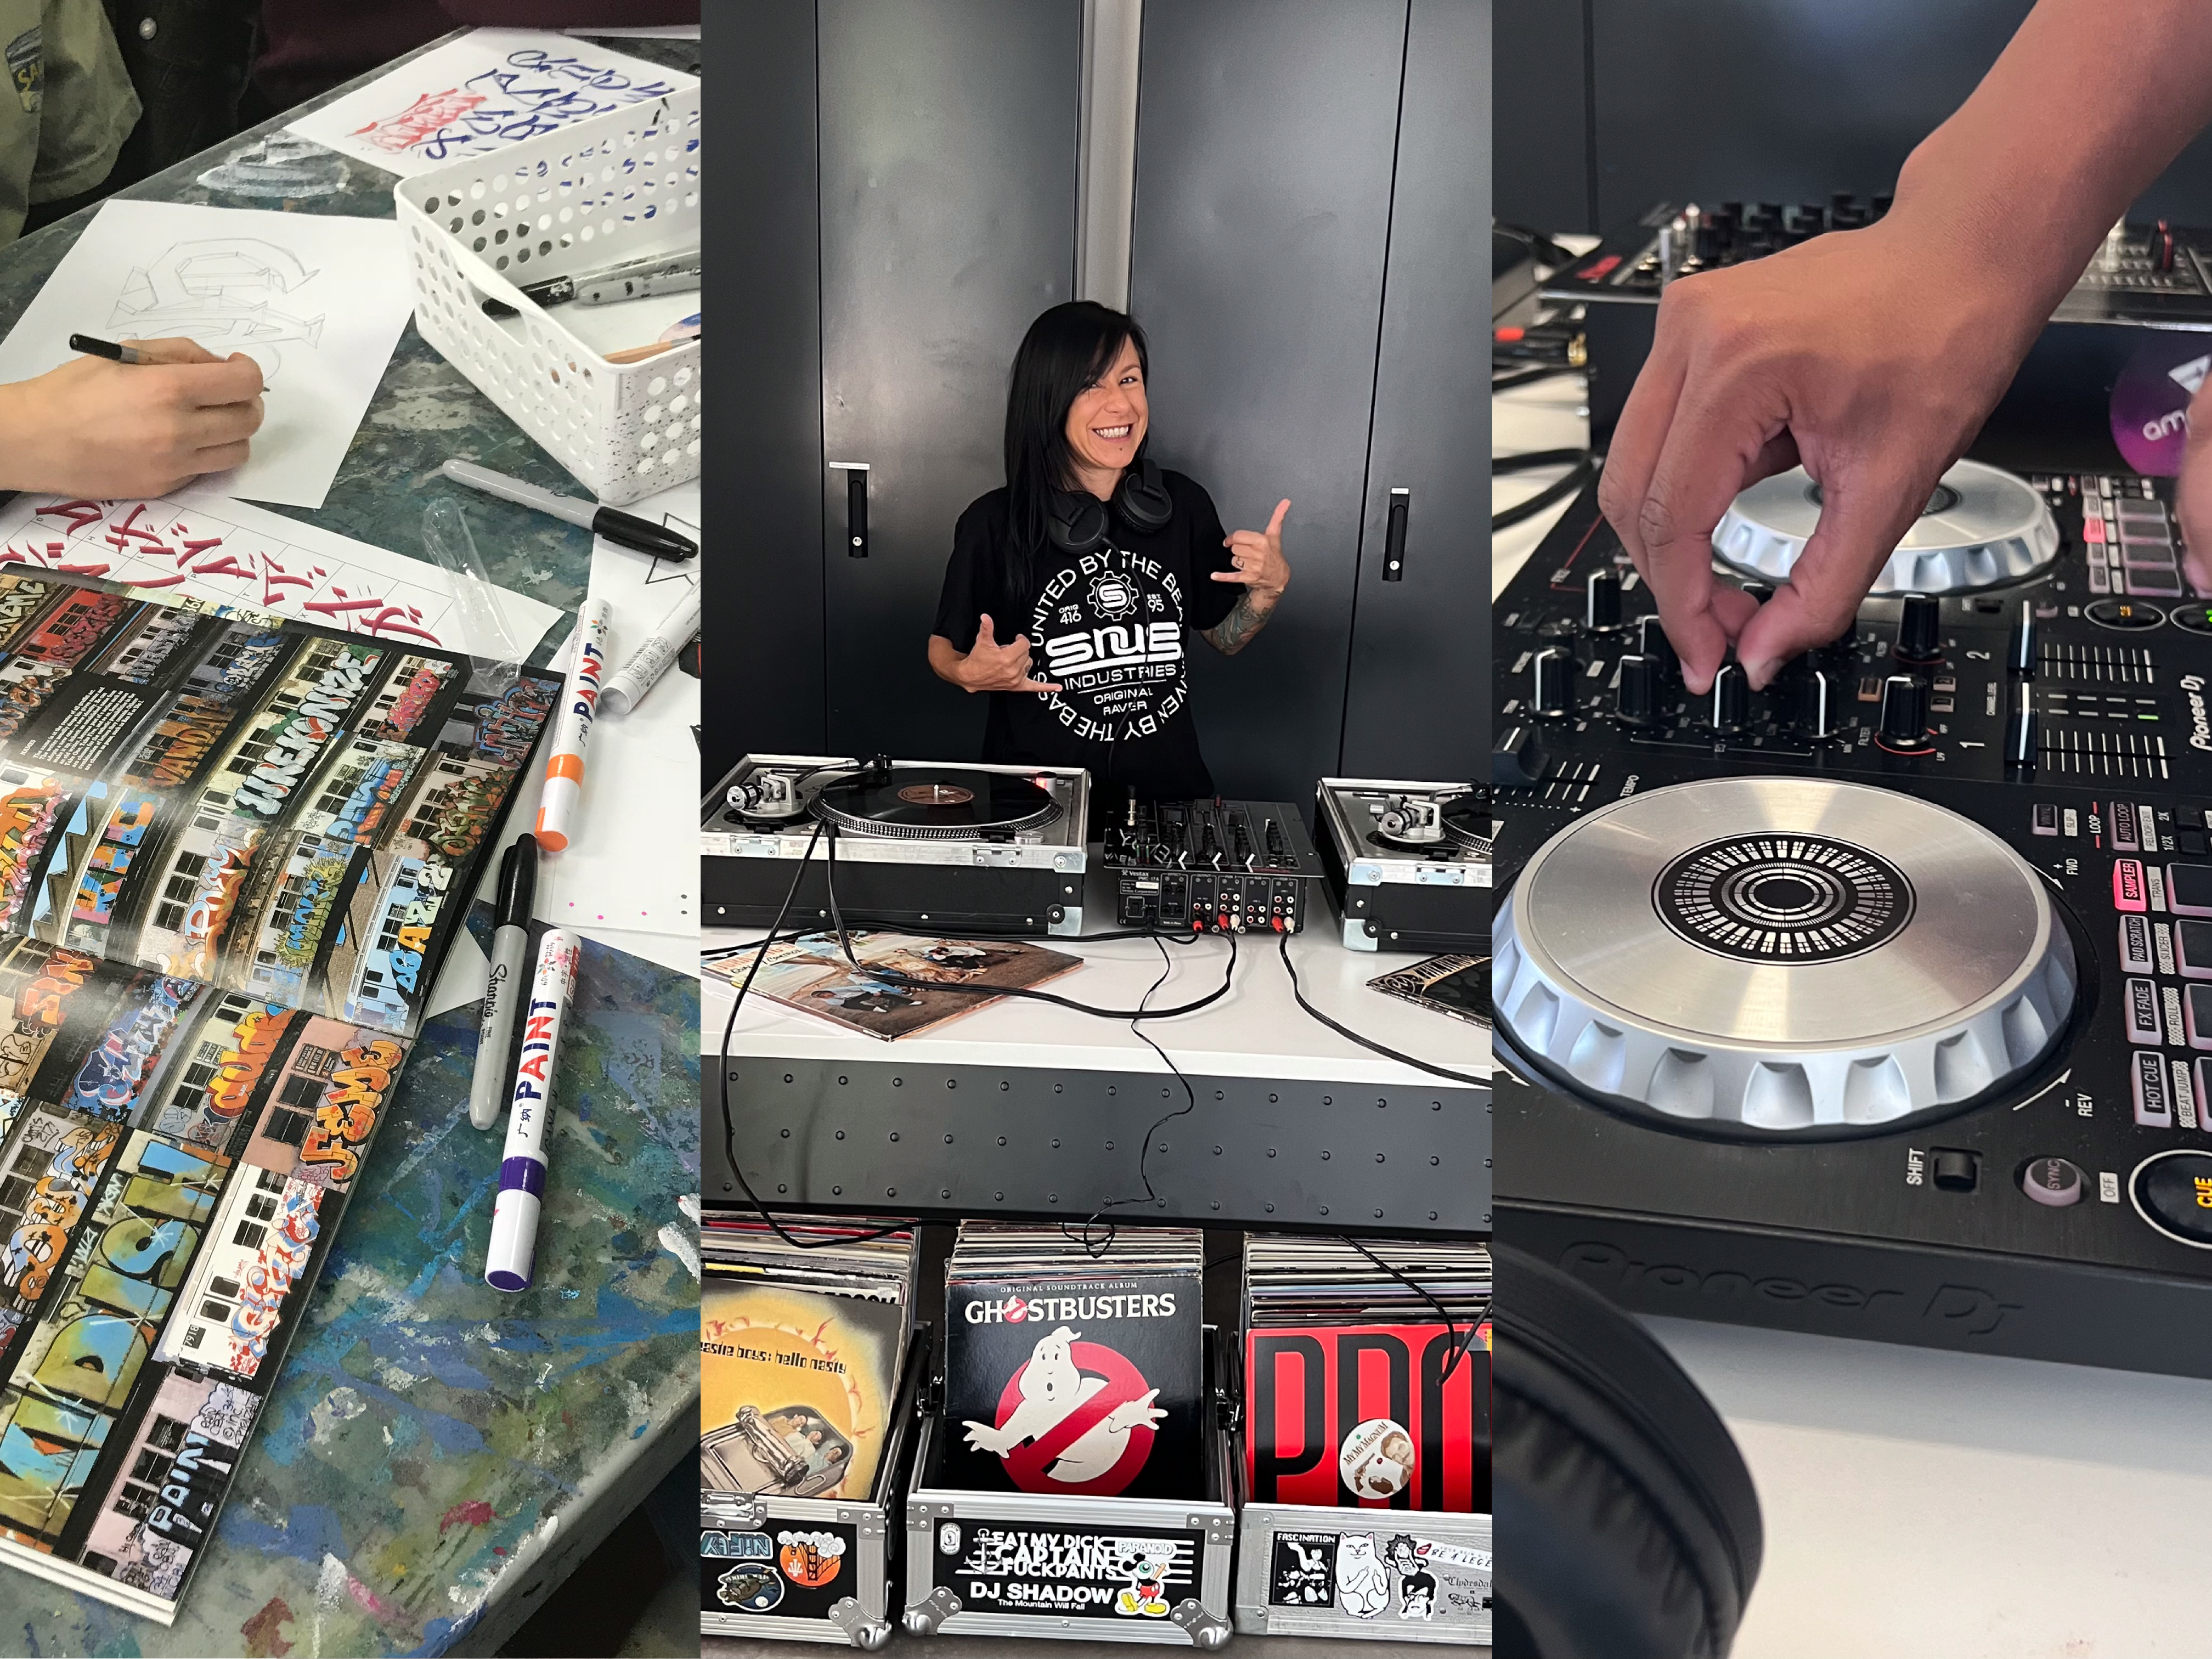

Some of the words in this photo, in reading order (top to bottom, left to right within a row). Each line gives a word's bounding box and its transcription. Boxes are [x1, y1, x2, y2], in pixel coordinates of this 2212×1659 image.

[1031, 569, 1076, 646] UNITED
[1079, 549, 1111, 575] BY
[1120, 550, 1162, 580] THE
[1148, 599, 1164, 612] 95
[1060, 611, 1081, 624] 416
[1966, 651, 1990, 660] 2
[573, 642, 605, 724] PAINT
[1064, 664, 1176, 690] INDUSTRIES
[1094, 687, 1153, 704] ORIGINAL
[1103, 701, 1147, 715] RAVER
[1074, 716, 1114, 741] THE
[1124, 715, 1157, 740] BY
[2188, 692, 2212, 751] Pioneer
[20, 740, 36, 755] NAMES
[1620, 775, 1639, 797] TEMPO
[2117, 803, 2130, 822] LOOP
[2157, 811, 2170, 821] 2X
[2089, 814, 2102, 833] LOOP
[2119, 822, 2132, 842] AUTO
[2160, 835, 2175, 850] 1/2X
[2066, 857, 2079, 875] FWD
[2122, 862, 2138, 898] SAMPLER
[2150, 878, 2162, 898] TRANS
[2129, 917, 2143, 947] SCRATCH
[2132, 947, 2146, 962] PAD
[2158, 935, 2171, 961] SLICER
[484, 963, 507, 1018] Sharpie
[2137, 985, 2152, 1009] FADE
[2138, 1011, 2153, 1026] FX
[2169, 1005, 2180, 1026] ROLL
[515, 997, 556, 1103] PAINT
[2143, 1059, 2159, 1082] CUE
[2176, 1070, 2190, 1093] JUMP
[2078, 1093, 2092, 1117] REV
[2147, 1088, 2163, 1109] HOT
[2179, 1094, 2193, 1117] BEAT
[1906, 1148, 1925, 1186] SHIFT
[2047, 1158, 2061, 1189] SYNC
[2103, 1178, 2117, 1198] OFF
[1559, 1240, 1904, 1310] Pioneer
[738, 1344, 772, 1362] boys:
[775, 1350, 806, 1368] hello
[810, 1358, 847, 1374] nasty
[1343, 1454, 1356, 1465] MY
[1352, 1446, 1364, 1457] MY
[1361, 1421, 1389, 1449] MAGNUM
[148, 1431, 211, 1532] PAIN
[994, 1531, 1029, 1547] EAT
[1030, 1534, 1060, 1548] MY
[1064, 1535, 1105, 1549] DICK
[1118, 1541, 1173, 1555] PARANOID
[1277, 1533, 1336, 1543] FASCINATION
[995, 1544, 1111, 1565] CAPTAIN
[1431, 1548, 1446, 1557] BE
[1003, 1562, 1118, 1581] FUCKPANTS
[970, 1582, 1001, 1599] DJ
[1007, 1583, 1114, 1604] SHADOW
[998, 1599, 1013, 1607] The
[1015, 1600, 1052, 1609] Mountain
[1054, 1601, 1069, 1610] Will
[1070, 1601, 1085, 1610] Fall
